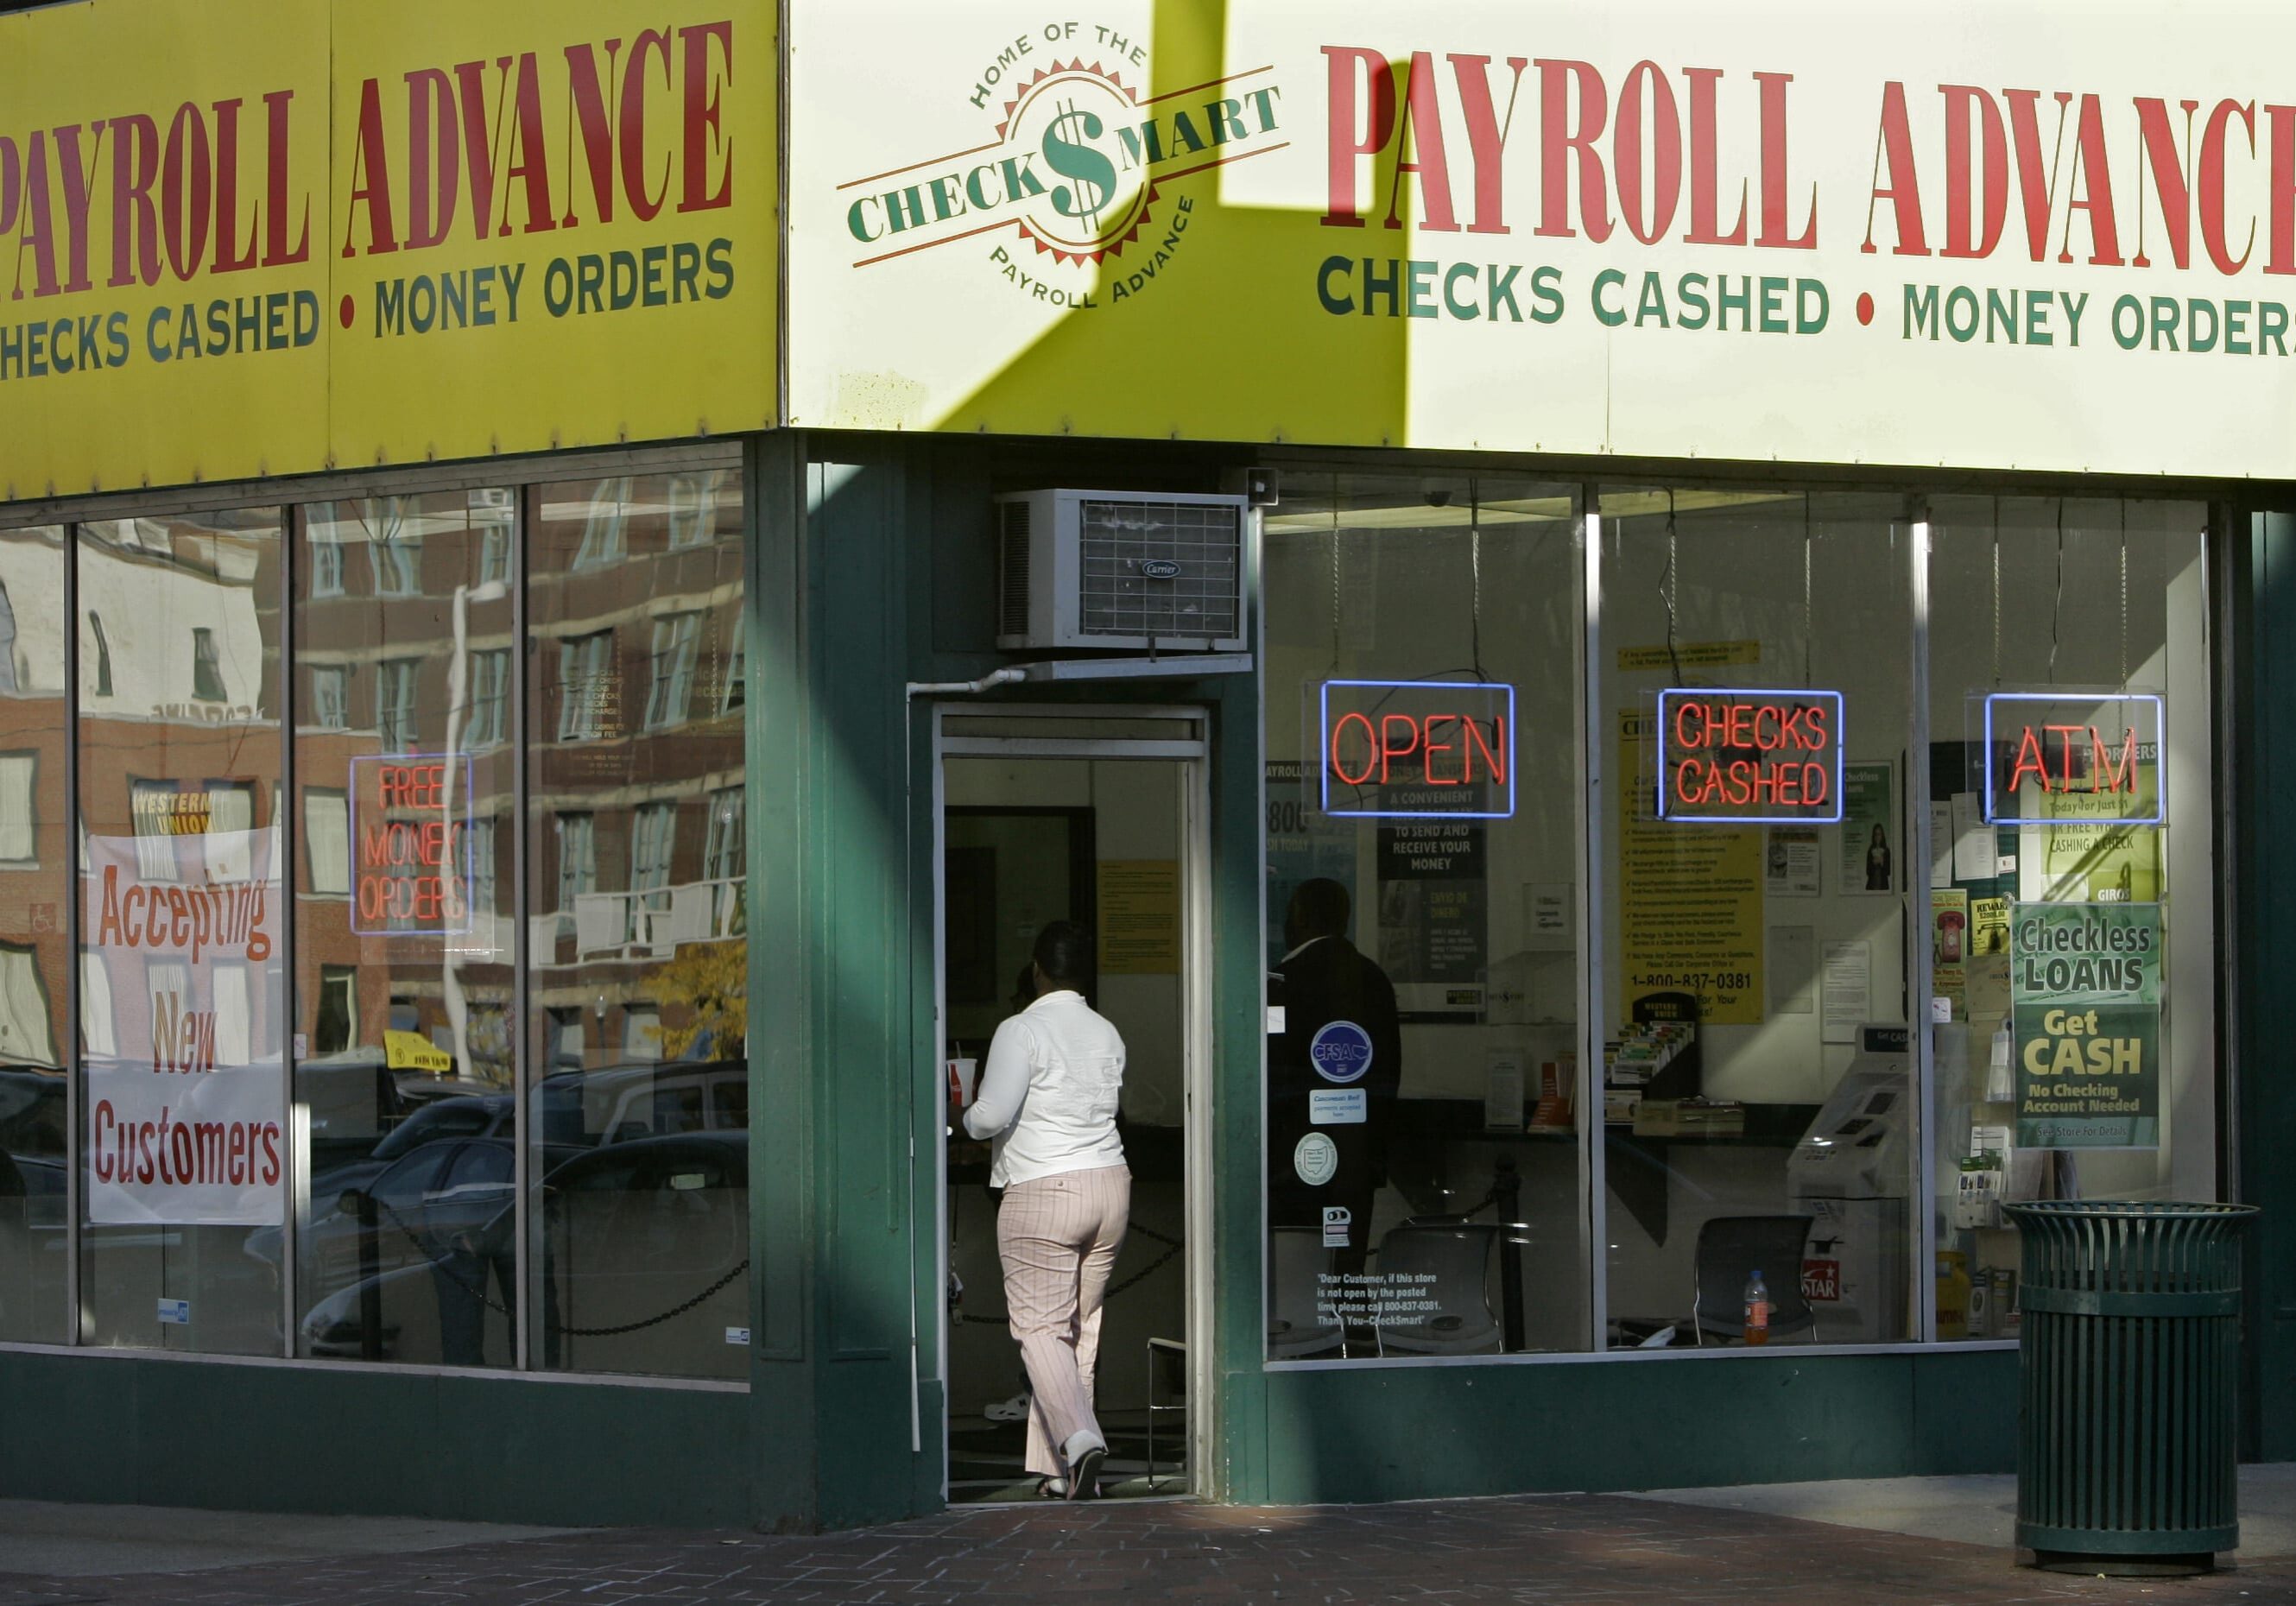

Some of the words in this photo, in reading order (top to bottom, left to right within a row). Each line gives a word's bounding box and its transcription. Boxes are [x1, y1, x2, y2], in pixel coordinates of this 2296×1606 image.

[970, 33, 1033, 111] HOME
[1044, 22, 1079, 43] OF
[1096, 25, 1148, 67] THE
[342, 21, 732, 258] ADVANCE
[1319, 44, 1818, 250] PAYROLL
[990, 244, 1097, 309] PAYROLL
[1112, 193, 1196, 304] ADVANCE
[0, 312, 130, 381] HECKS
[147, 289, 320, 364] CASHED
[375, 262, 525, 338] MONEY
[545, 237, 734, 319] ORDERS
[1318, 255, 1565, 325] CHECKS
[1591, 269, 1830, 335] CASHED
[1902, 282, 2090, 347] MONEY
[2111, 294, 2296, 357] ORDER
[1147, 565, 1177, 574] Carrier
[1676, 703, 1827, 750] CHECKS
[1331, 713, 1504, 785] OPEN
[2103, 746, 2157, 762] ORERS
[2008, 725, 2136, 794] ATM
[378, 765, 449, 810] FREE
[1676, 759, 1827, 806] CASHED
[133, 793, 212, 813] WESTERN
[1390, 793, 1398, 805] A
[1401, 791, 1474, 804] CONVENIENT
[2049, 800, 2078, 813] Today
[2097, 800, 2116, 812] Just
[157, 815, 212, 836] UNION
[1395, 825, 1408, 838] TO
[1412, 825, 1440, 838] SEND
[1443, 825, 1469, 837] AND
[2067, 823, 2090, 834] FREE
[364, 822, 462, 868] MONEY
[1393, 841, 1438, 854] RECEIVE
[1439, 841, 1471, 853] YOUR
[2051, 838, 2090, 853] CASHING
[2103, 836, 2135, 850] CHECK
[1411, 858, 1452, 870] MONEY
[359, 876, 466, 920] ORDERS
[2097, 888, 2130, 902] GIROS
[98, 865, 271, 964] Accepting
[1977, 901, 2010, 914] REWAR
[2020, 917, 2150, 952] Checkless
[1630, 972, 1751, 990] 1-800-837-0381
[2024, 958, 2144, 992] LOANS
[1717, 994, 1737, 1005] Your
[154, 991, 218, 1073] New
[2044, 1009, 2098, 1036] Get
[2024, 1038, 2141, 1076] CASH
[2029, 1084, 2050, 1097] No
[2052, 1083, 2118, 1099] Checking
[2023, 1099, 2085, 1113] Account
[2089, 1098, 2140, 1112] Needed
[2037, 1125, 2053, 1137] See
[2057, 1124, 2079, 1137] Store
[2083, 1125, 2097, 1136] For
[2098, 1124, 2127, 1136] Details
[95, 1099, 281, 1186] Customers
[1343, 1274, 1387, 1286] Customer,
[1388, 1273, 1395, 1283] if
[1395, 1273, 1412, 1283] this
[1414, 1273, 1437, 1283] store
[1802, 1278, 1836, 1298] STAR
[1317, 1287, 1325, 1298] is
[1327, 1287, 1342, 1298] not
[1344, 1289, 1366, 1299] open
[1367, 1288, 1378, 1299] by
[1380, 1287, 1394, 1297] the
[1396, 1287, 1426, 1299] posted
[1317, 1301, 1336, 1312] time
[1338, 1301, 1366, 1313] please
